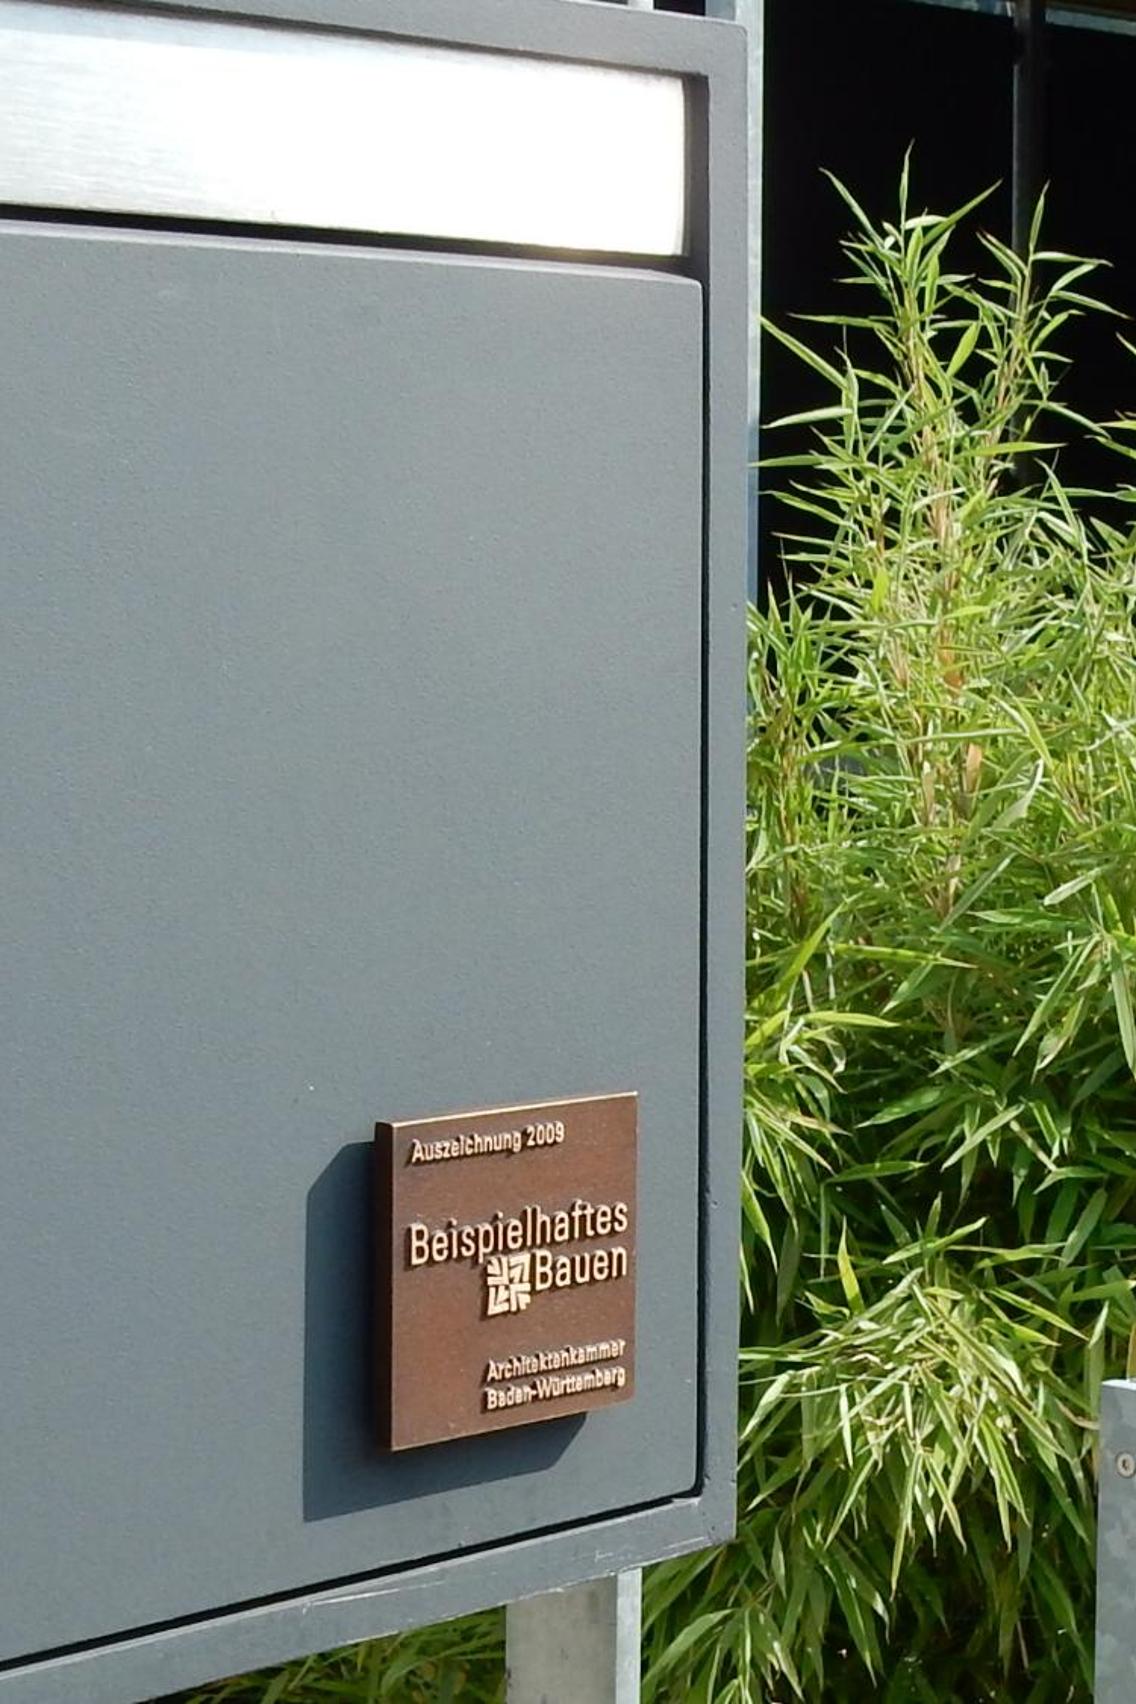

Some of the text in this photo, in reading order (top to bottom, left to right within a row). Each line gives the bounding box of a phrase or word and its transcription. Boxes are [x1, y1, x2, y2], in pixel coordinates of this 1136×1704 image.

[411, 1121, 565, 1164] Auszeichnung 2009
[410, 1198, 628, 1266] Beispielhaftes
[535, 1246, 627, 1291] Bauen
[487, 1339, 626, 1382] Architektenkammer
[486, 1366, 626, 1410] Baden-Württemberg
